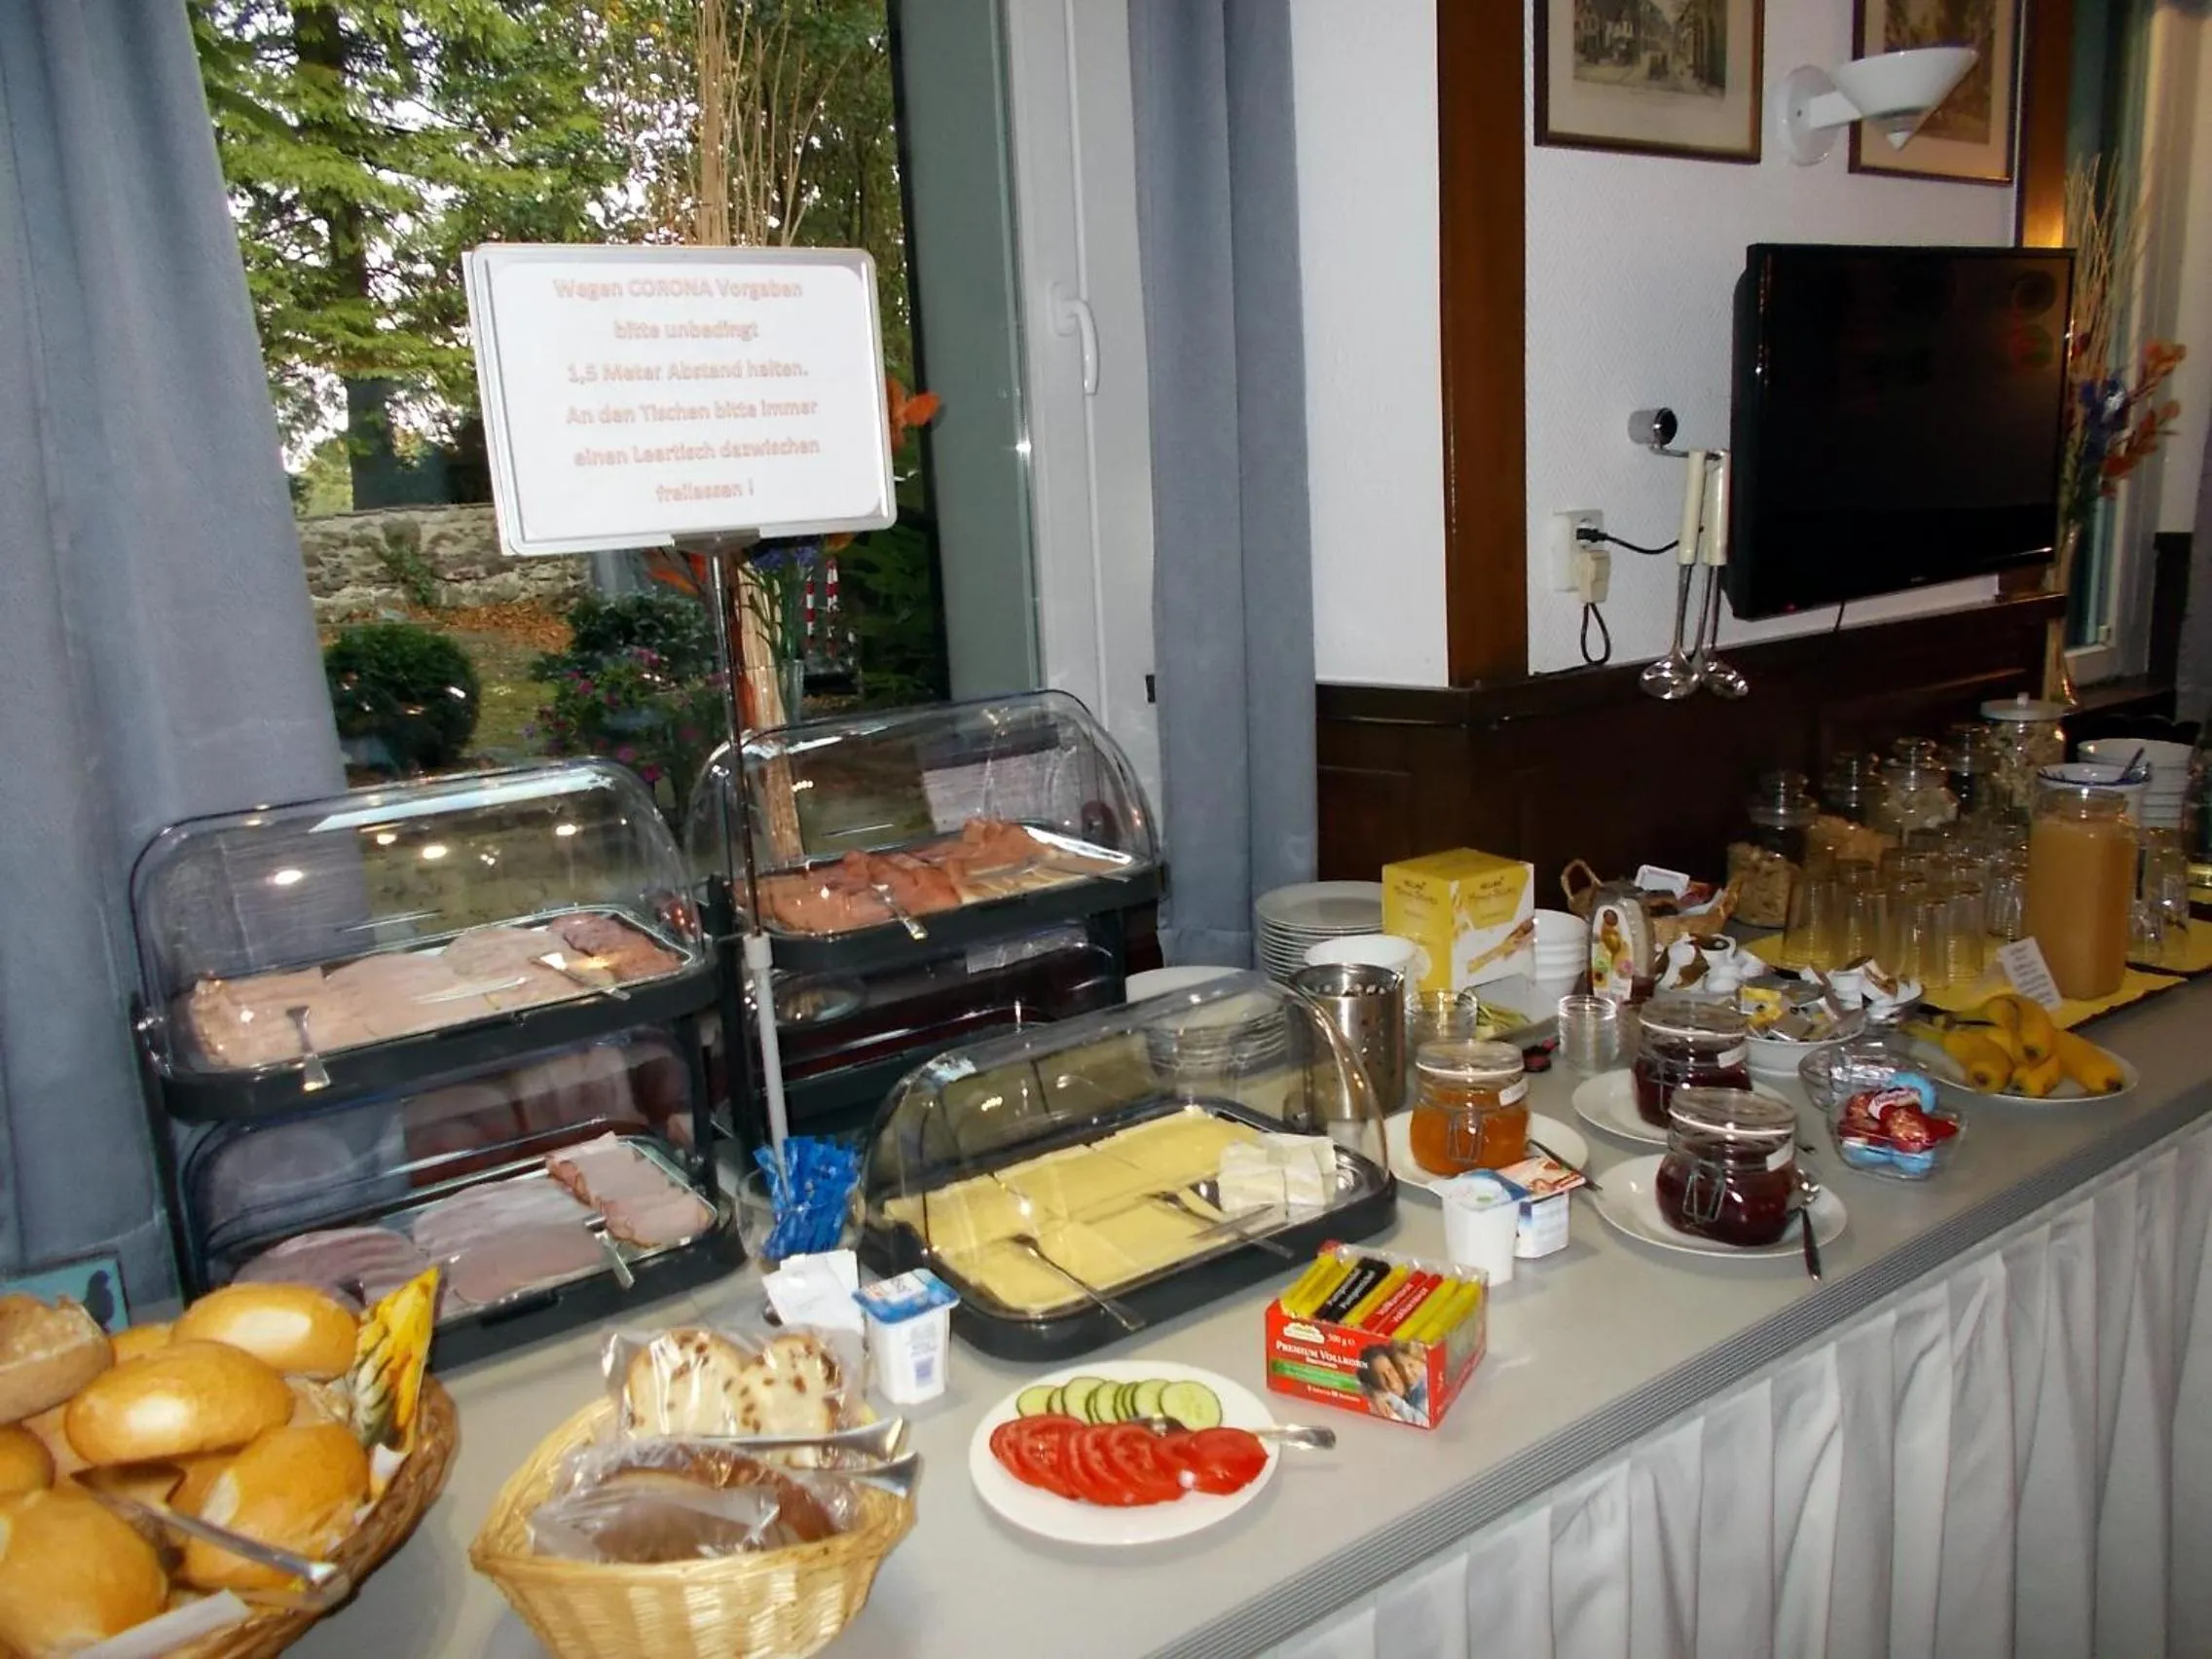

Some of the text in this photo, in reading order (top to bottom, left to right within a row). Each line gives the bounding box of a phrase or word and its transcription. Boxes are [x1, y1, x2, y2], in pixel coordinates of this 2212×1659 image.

[552, 278, 803, 301] Wegen CORONA Vorgaben
[613, 319, 759, 342] bitte unbedingt
[567, 359, 809, 385] 1,5 Meter Abstand halten.
[566, 398, 818, 424] An den Tischen bitte immer
[573, 447, 628, 466] einen
[719, 436, 820, 458] dazwischen
